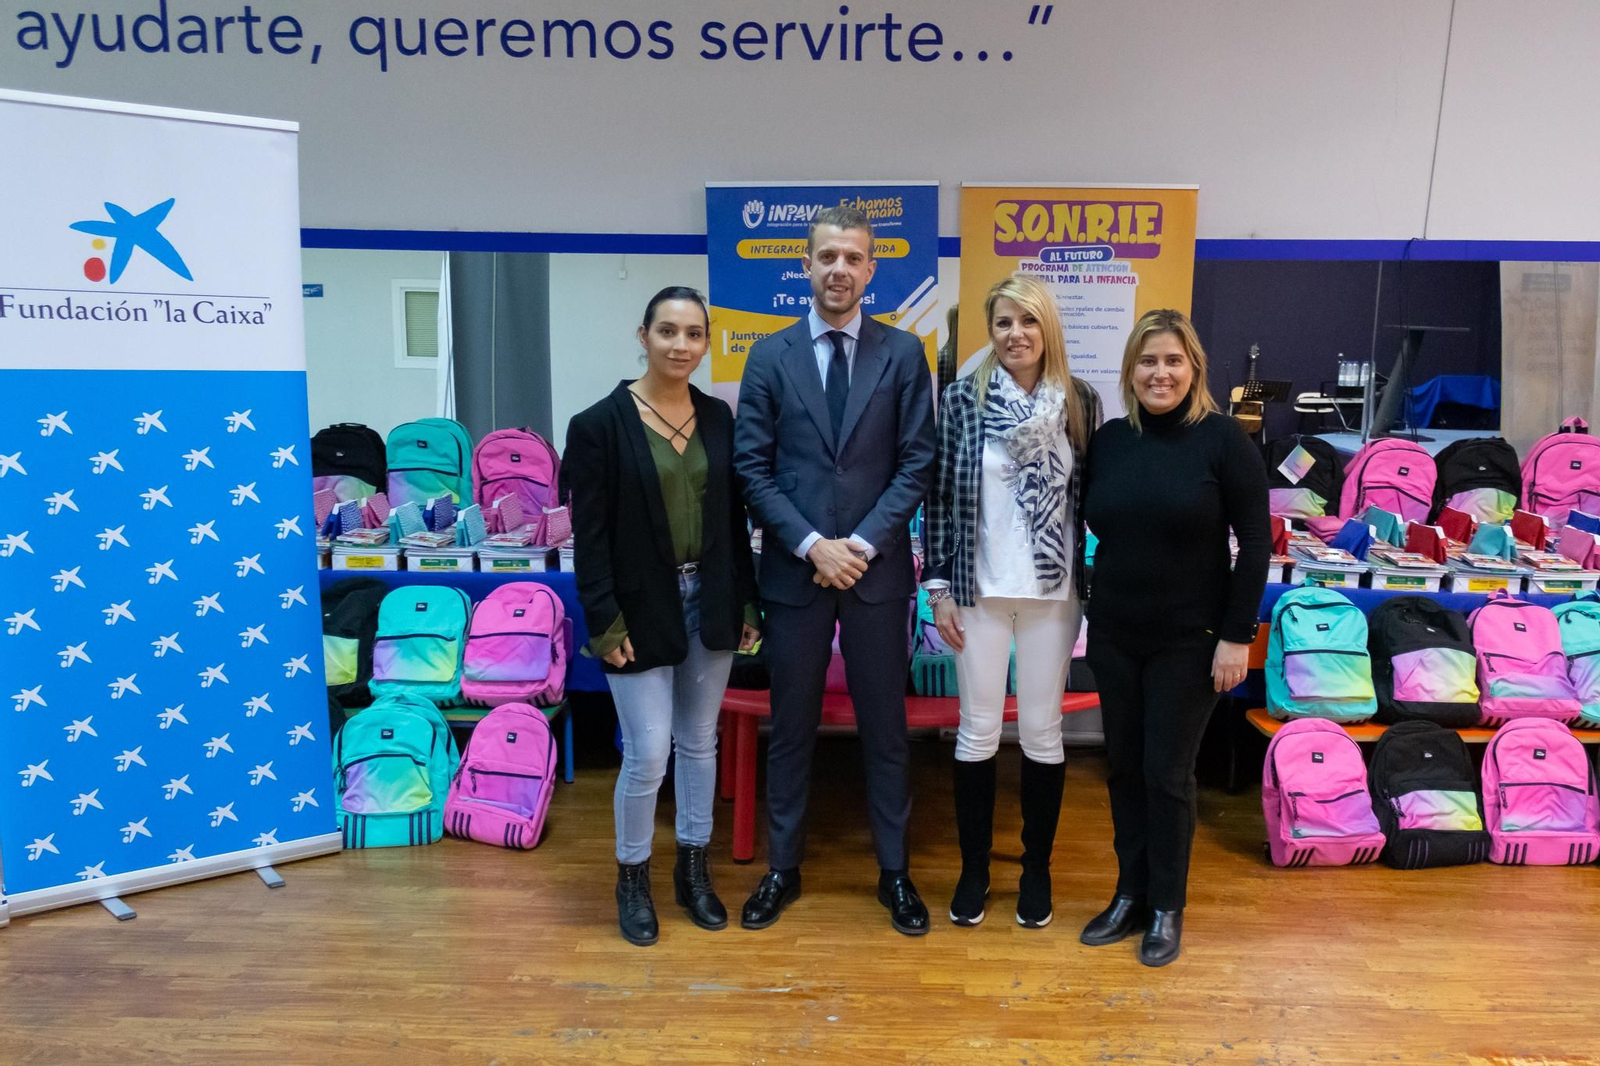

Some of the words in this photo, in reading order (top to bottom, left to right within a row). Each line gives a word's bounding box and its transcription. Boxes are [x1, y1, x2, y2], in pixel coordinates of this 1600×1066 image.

[16, 0, 323, 70] ayudarte,
[348, 15, 674, 73] queremos
[839, 195, 903, 211] Echamos
[866, 207, 904, 220] mano
[994, 202, 1163, 245] S.O.N.R.I.E.
[1049, 251, 1062, 262] AL
[1064, 250, 1104, 262] FUTURO
[1021, 262, 1070, 273] PROGRAMA
[1072, 263, 1084, 273] DE
[1086, 262, 1129, 274] ATENCIÓN
[1057, 274, 1081, 285] PARA
[1083, 274, 1094, 285] LA
[1096, 274, 1137, 285] INFANCIA
[773, 293, 796, 308] ¡Te
[0, 294, 148, 323] Fundación
[730, 343, 746, 353] de
